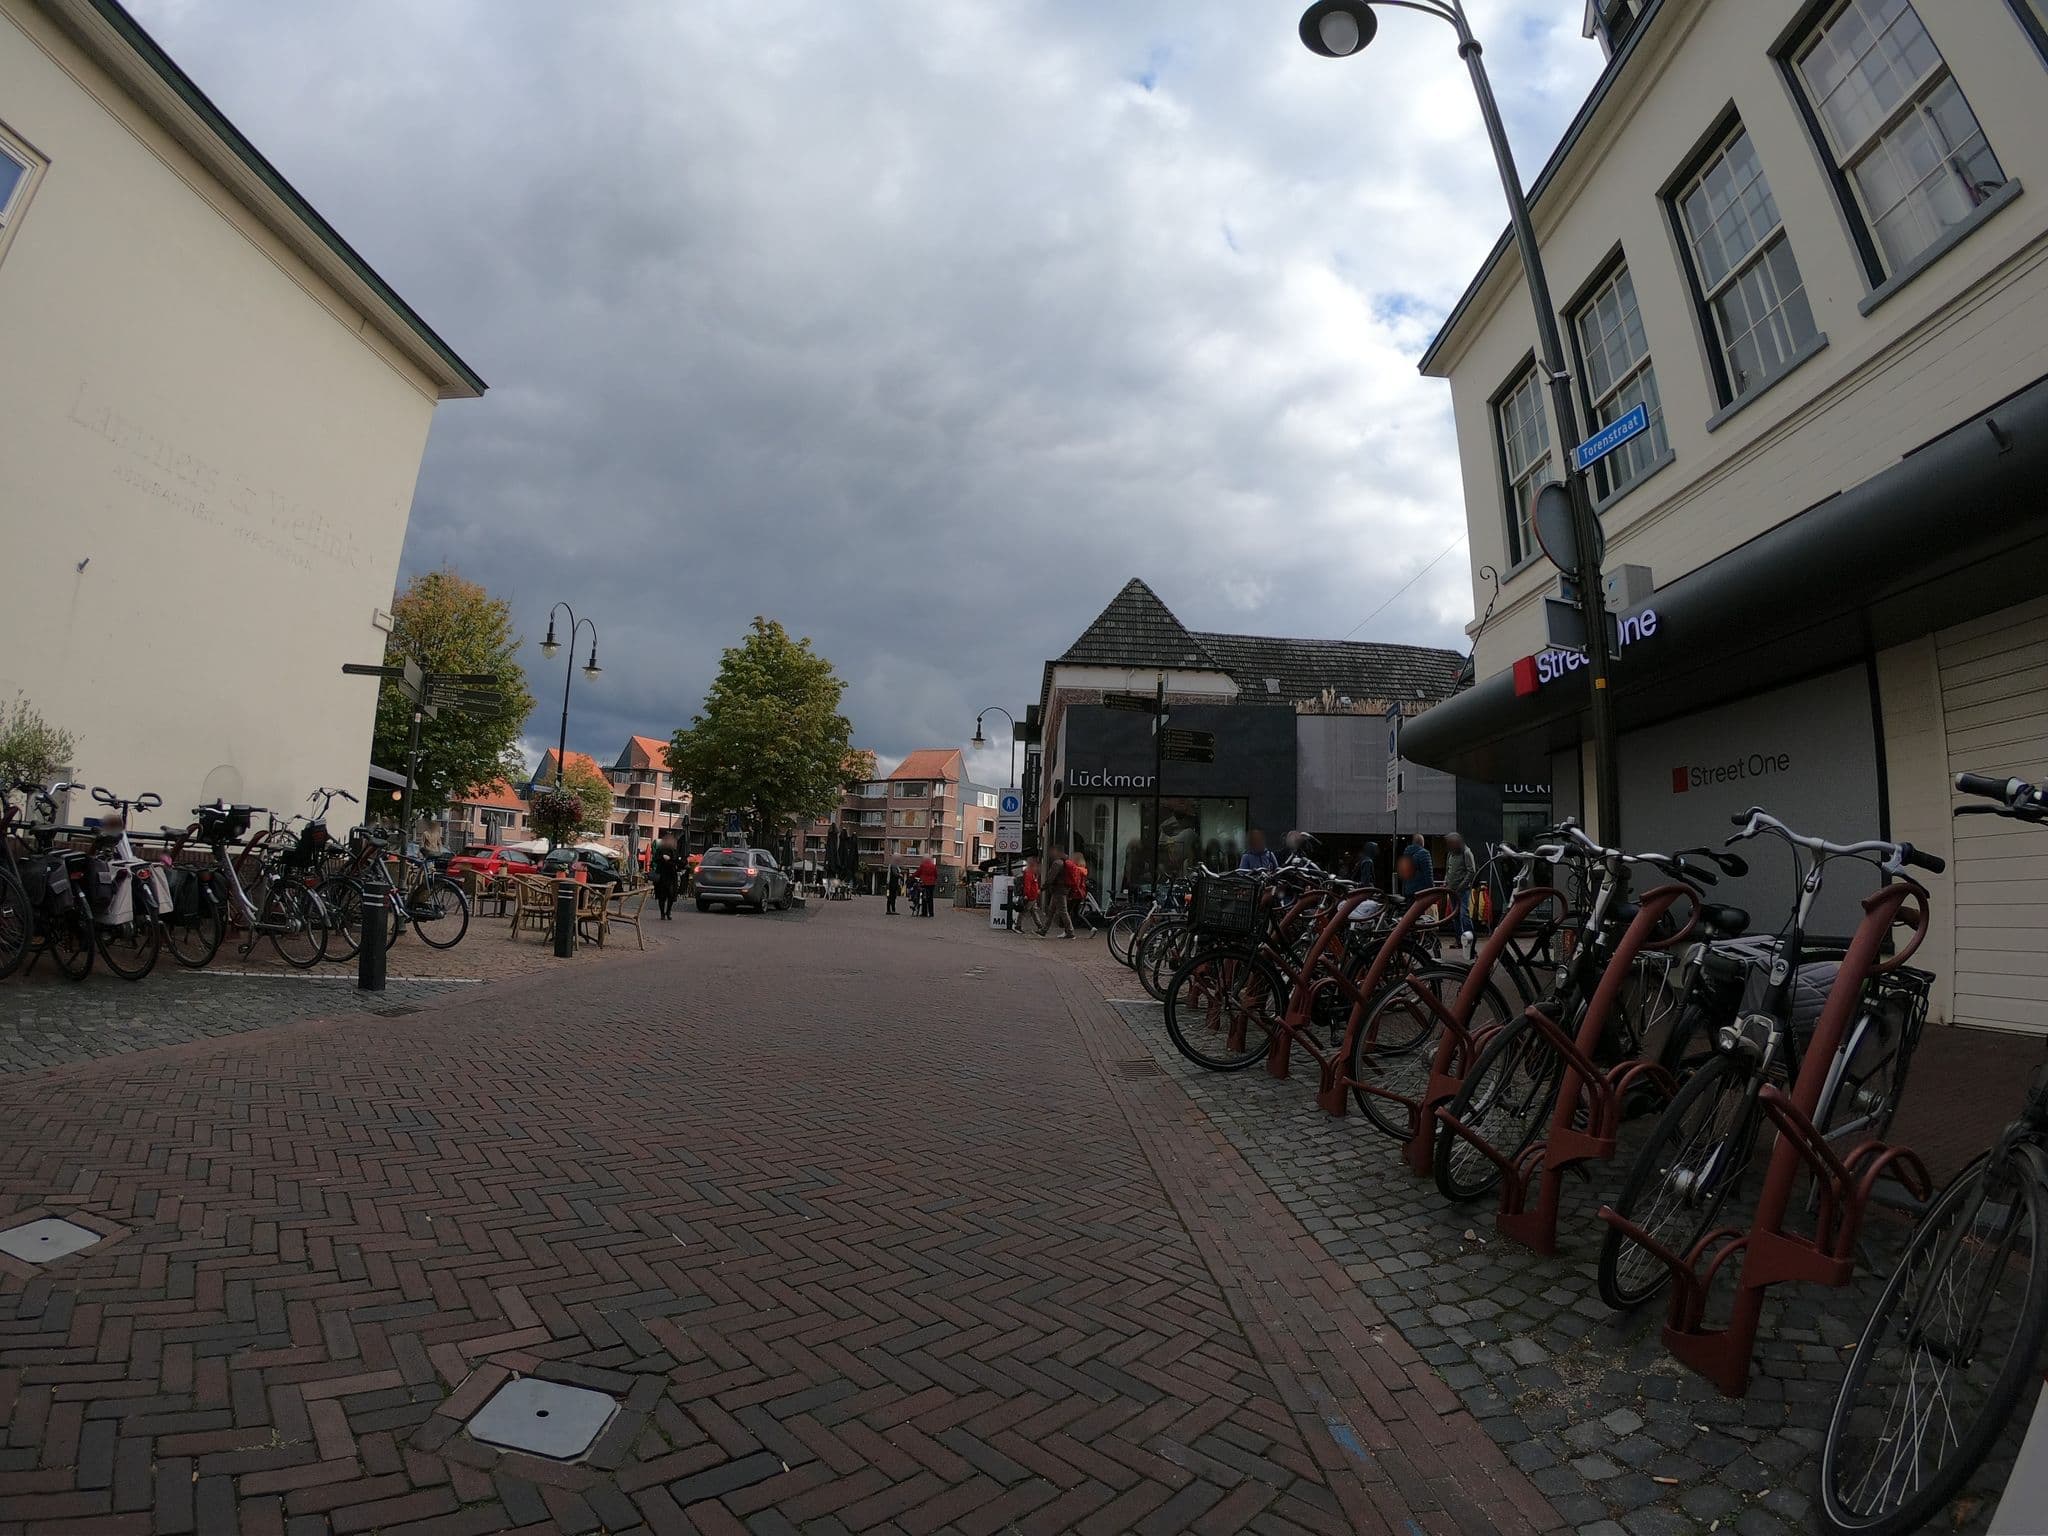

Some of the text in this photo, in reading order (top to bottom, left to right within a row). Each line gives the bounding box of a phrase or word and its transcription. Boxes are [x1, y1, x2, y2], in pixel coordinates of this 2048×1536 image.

[1583, 415, 1639, 459] Torenstraat
[1690, 753, 1790, 788] Street One
